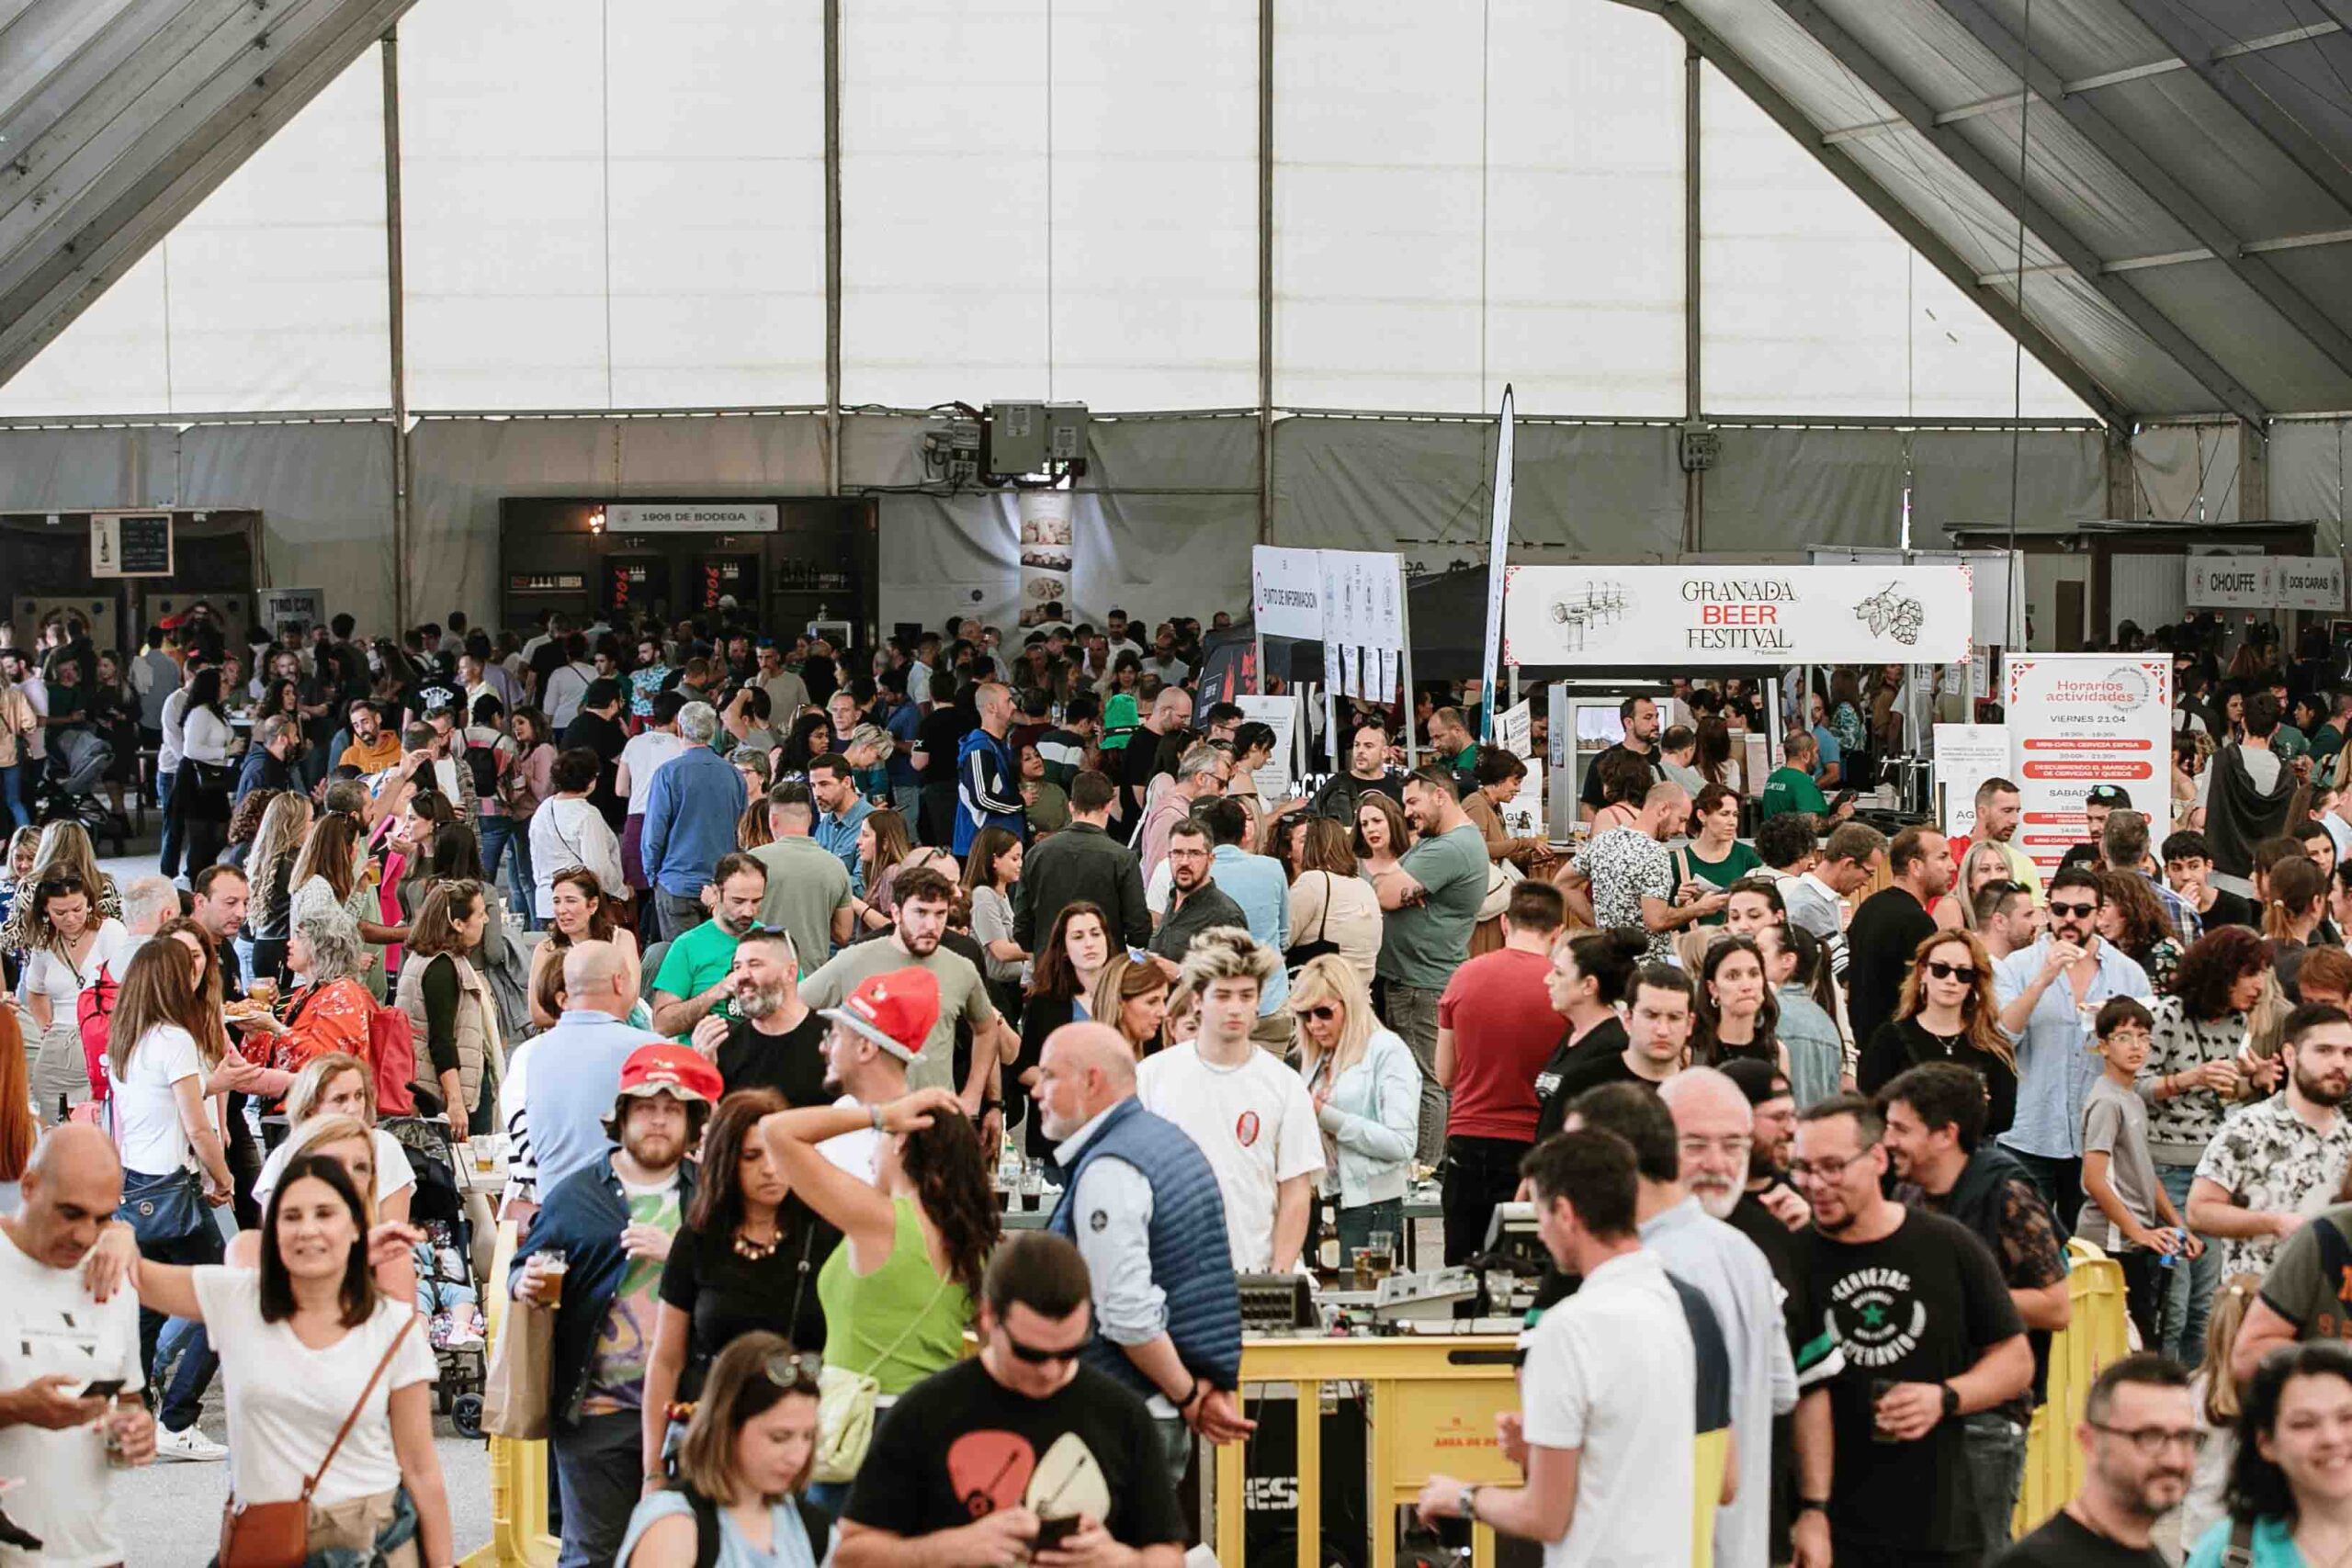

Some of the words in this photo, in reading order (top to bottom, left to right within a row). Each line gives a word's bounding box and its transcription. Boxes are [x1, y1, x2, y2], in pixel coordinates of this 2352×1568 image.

[675, 513, 690, 521] DE
[695, 513, 746, 522] BODEGA
[2211, 573, 2256, 592] CHOUFFE
[1682, 581, 1796, 602] GRANADA
[1702, 604, 1777, 625] BEER
[1687, 628, 1793, 649] FESTIVAL
[2057, 680, 2123, 691] Horarios
[2045, 691, 2135, 703] actividades
[1506, 811, 1532, 822] GUA
[1955, 810, 1975, 819] AG
